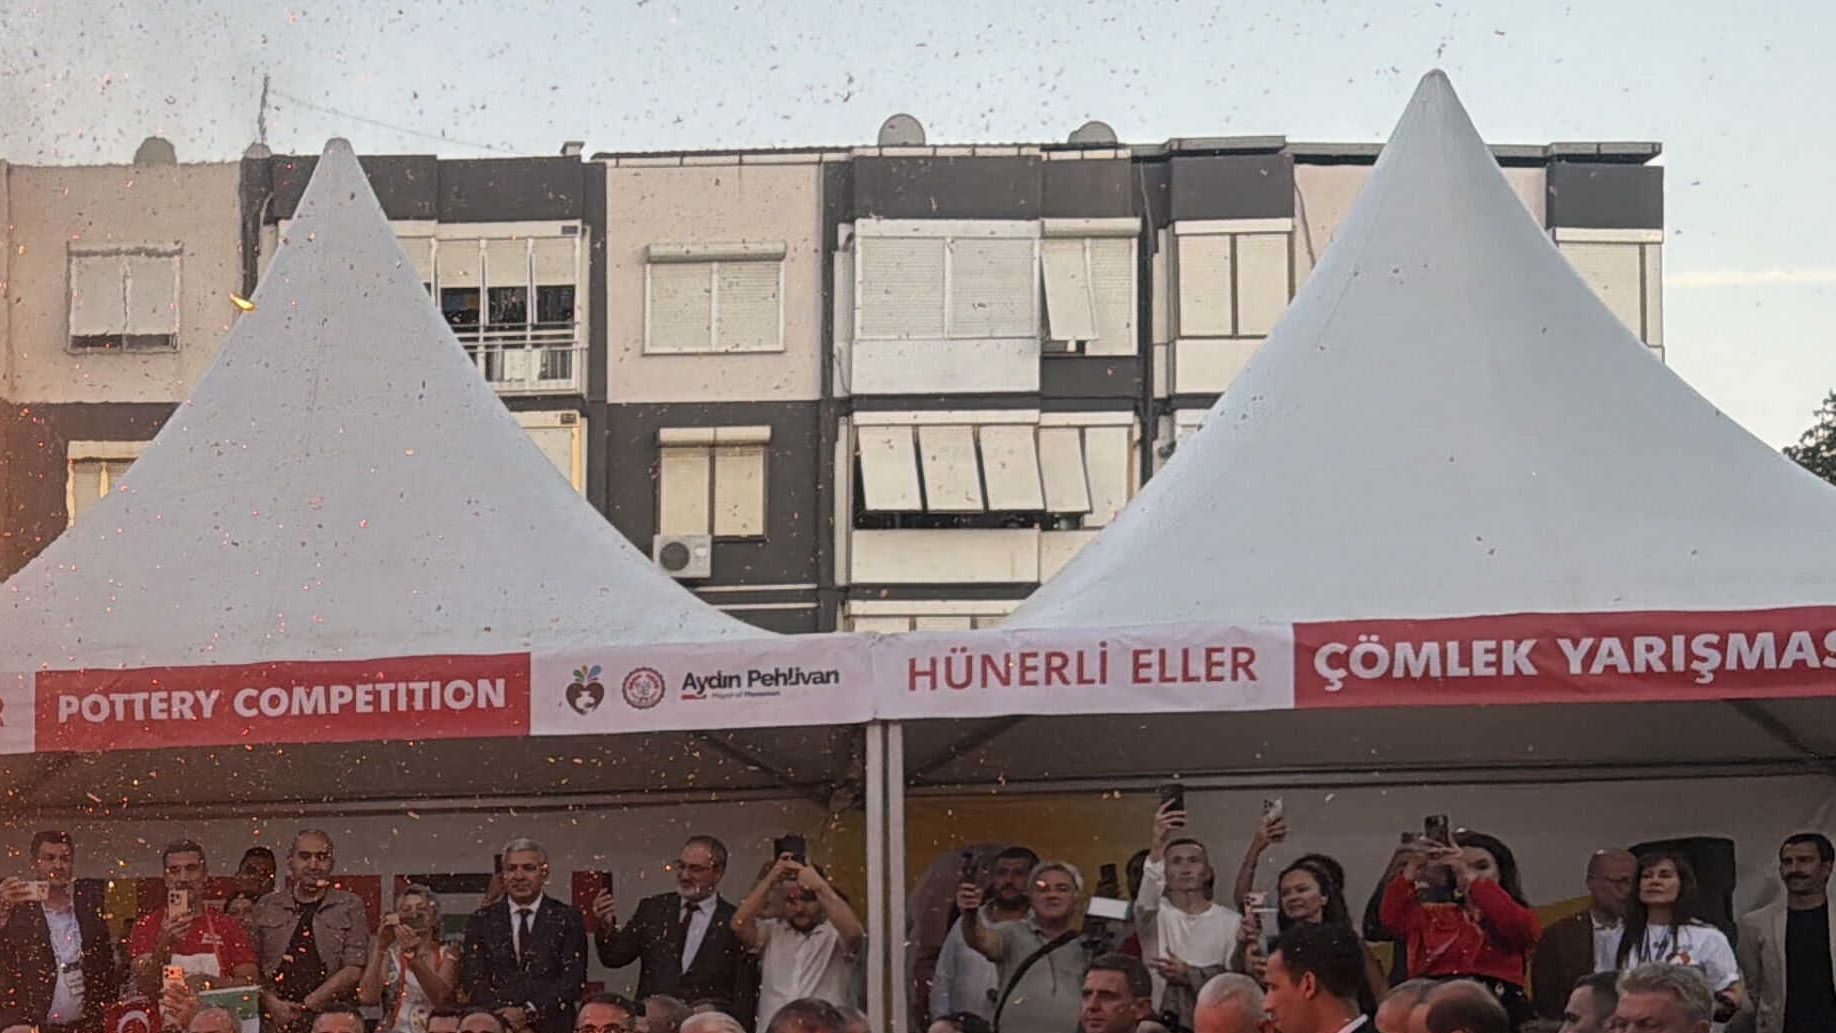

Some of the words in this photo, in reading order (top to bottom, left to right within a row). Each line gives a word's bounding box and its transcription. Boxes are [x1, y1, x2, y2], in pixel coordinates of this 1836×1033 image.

[681, 669, 742, 695] Aydın
[747, 666, 840, 688] Pehlivan
[907, 640, 1109, 692] HÜNERLİ
[1131, 646, 1258, 685] ELLER
[1313, 634, 1539, 692] ÇÖMLEK
[57, 689, 221, 724] POTTERY
[233, 678, 506, 717] COMPETITION
